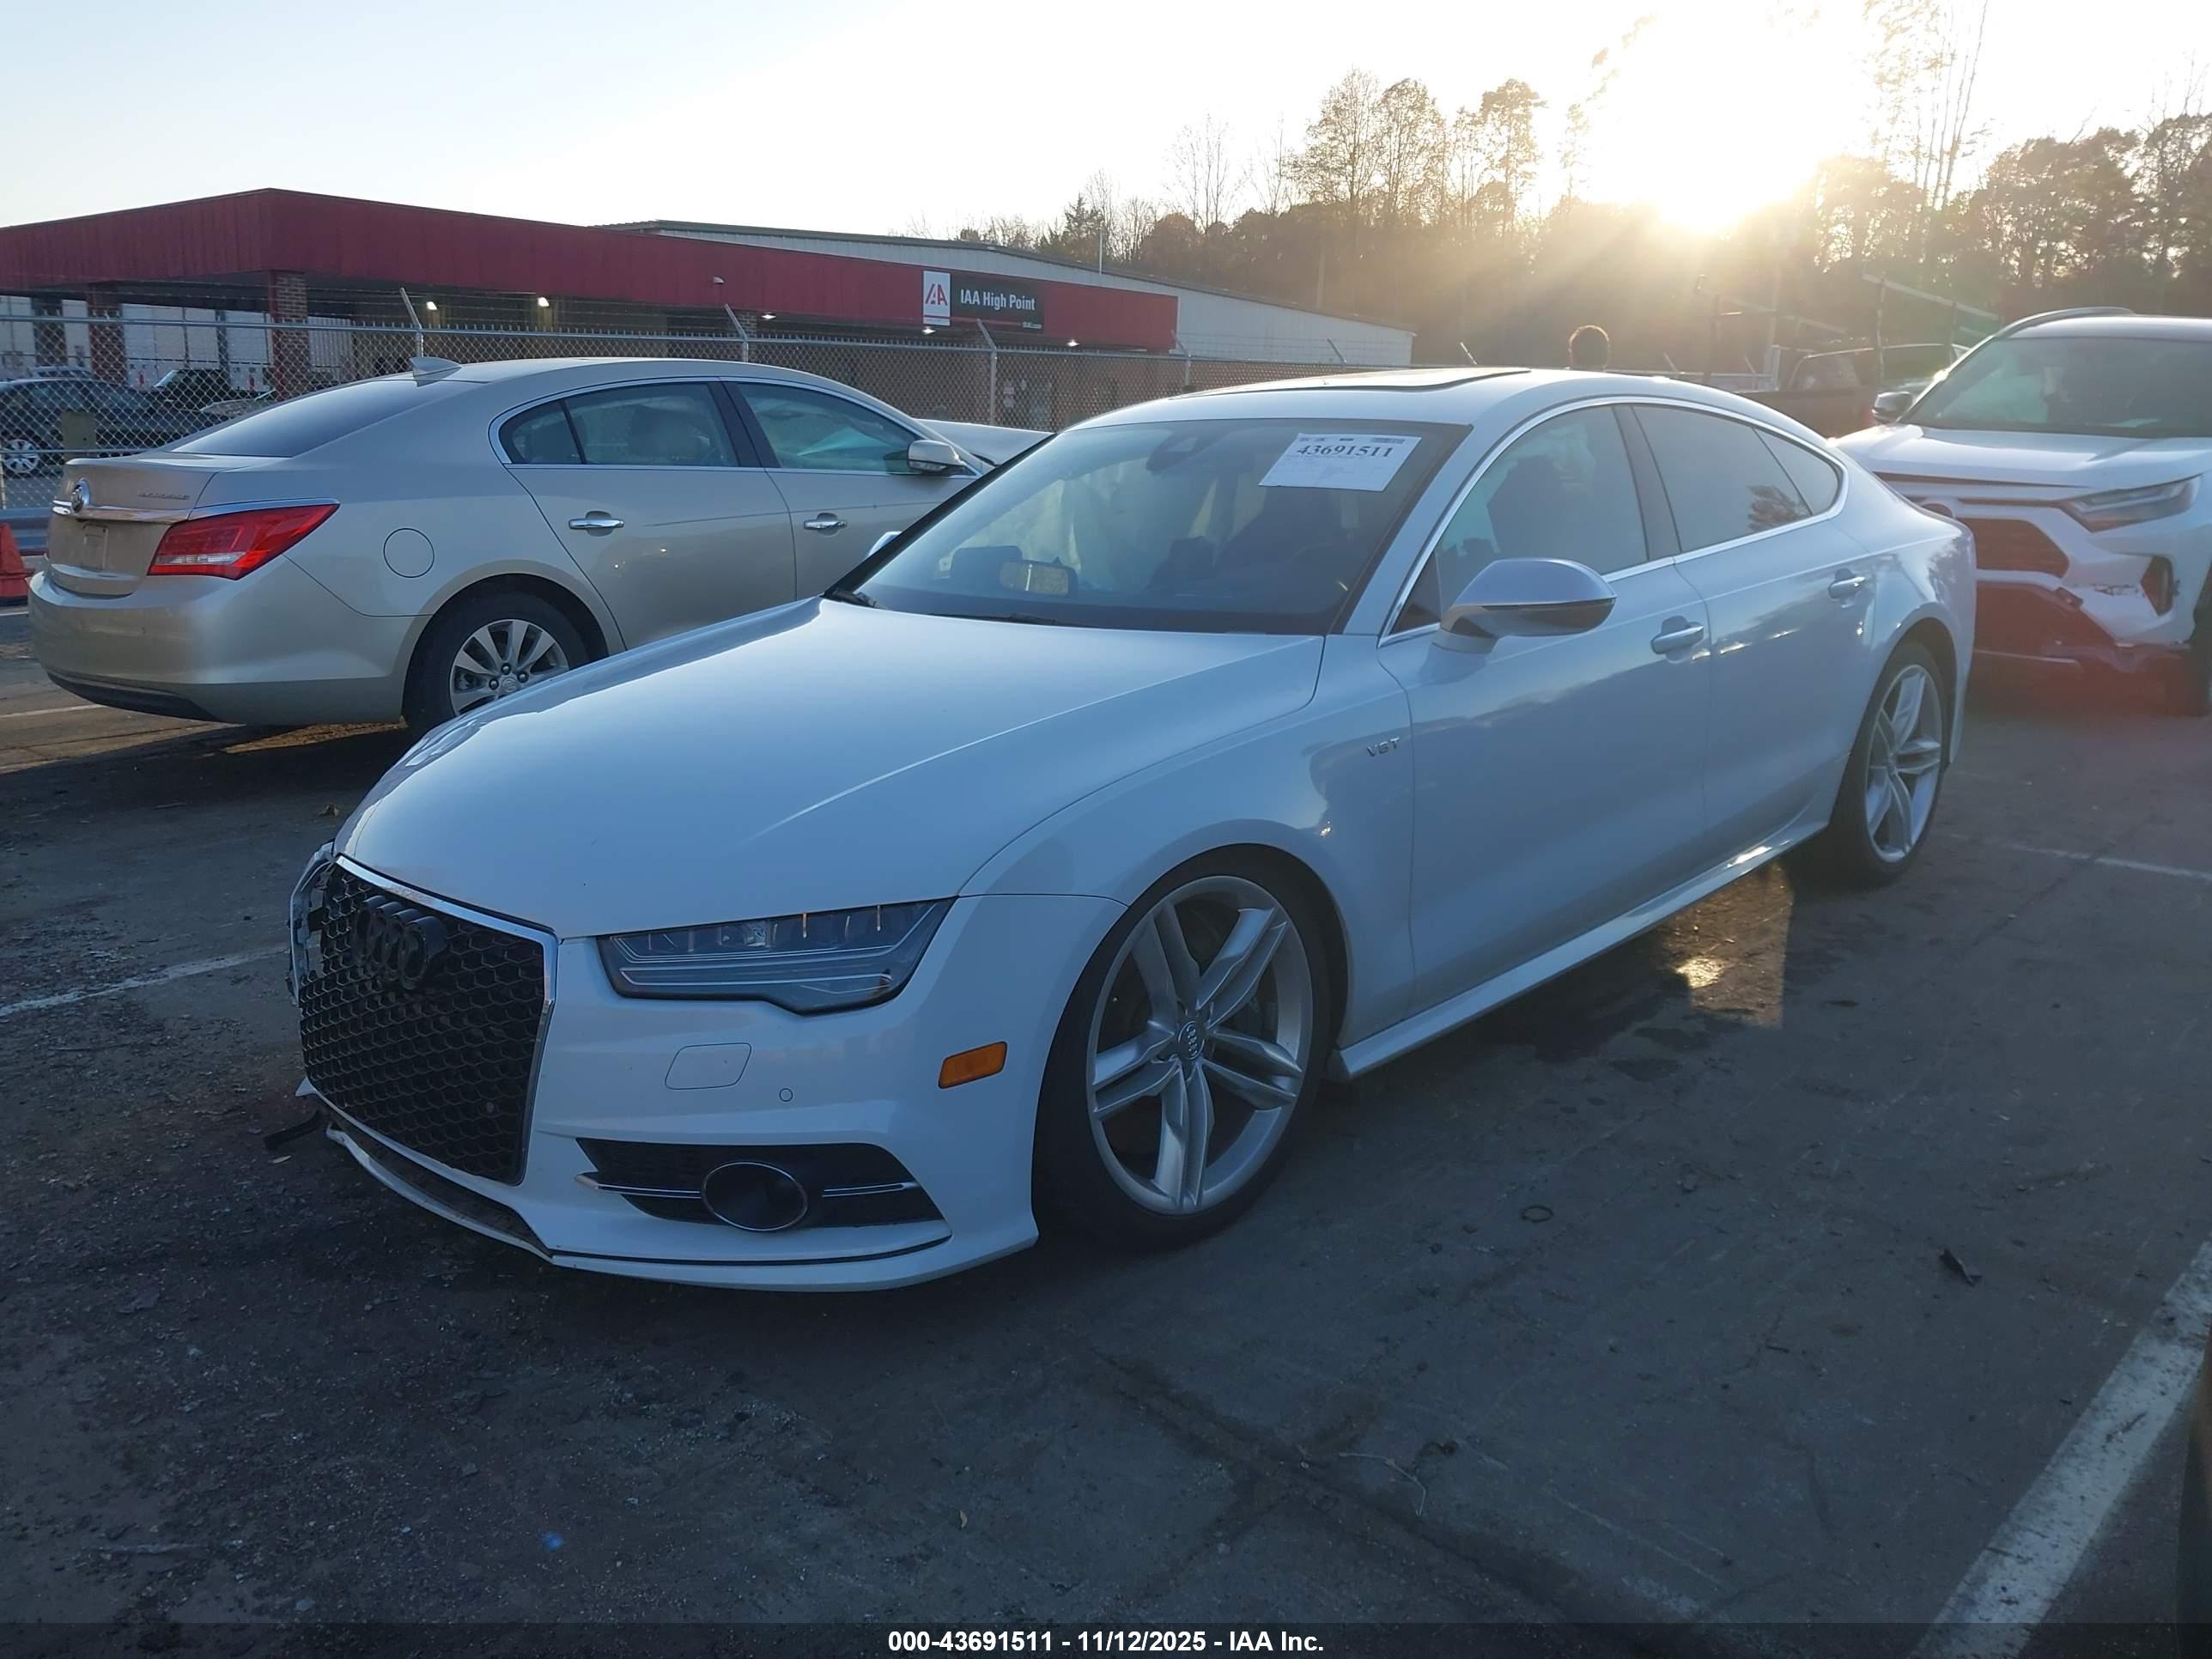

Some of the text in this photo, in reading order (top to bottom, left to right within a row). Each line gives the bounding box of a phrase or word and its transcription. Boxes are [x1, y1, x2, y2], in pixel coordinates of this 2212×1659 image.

[960, 289, 1036, 311] IAA High Point
[1297, 445, 1394, 458] 43691511
